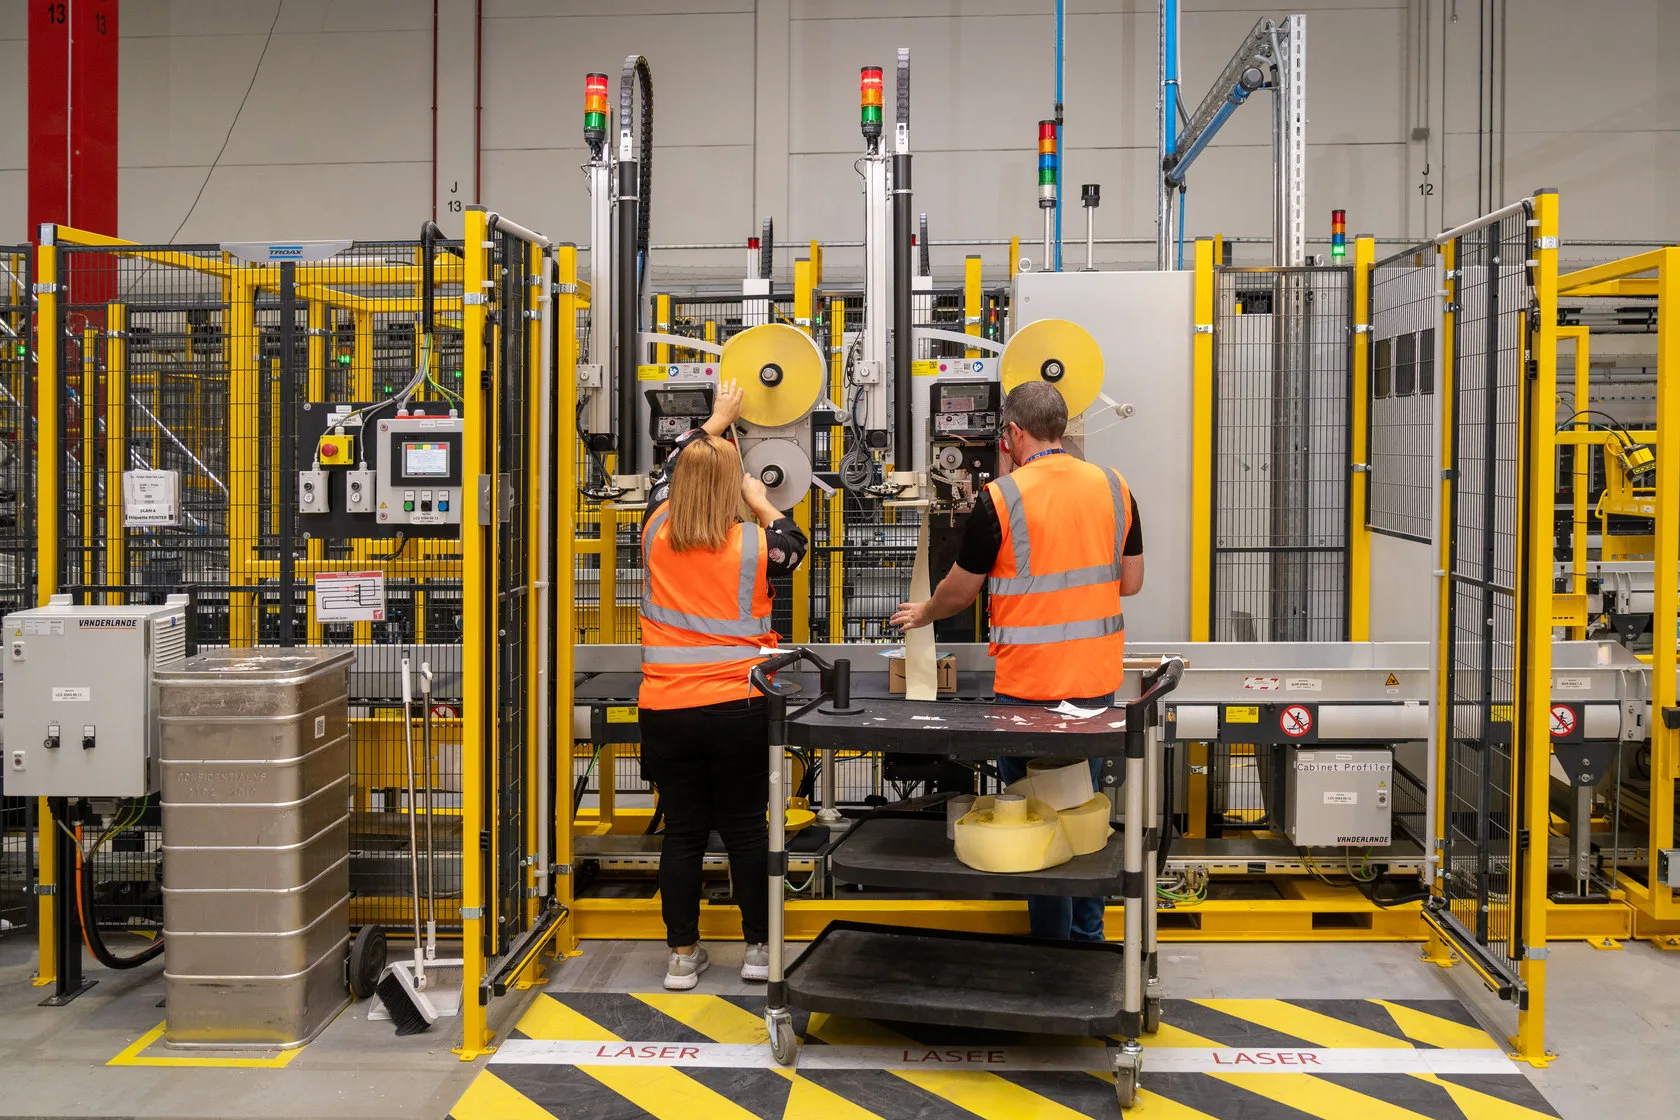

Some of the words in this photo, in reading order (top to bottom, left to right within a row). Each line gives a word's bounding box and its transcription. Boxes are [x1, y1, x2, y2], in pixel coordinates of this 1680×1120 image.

[48, 3, 66, 24] 13
[96, 13, 106, 35] 13
[1422, 163, 1430, 175] J
[450, 181, 458, 193] J
[1418, 183, 1434, 196] 12
[447, 200, 462, 212] 13
[79, 619, 137, 627] VANDERLANDE
[1297, 763, 1338, 771] Cabinet
[1344, 763, 1391, 772] Profiler
[596, 1045, 700, 1059] LASER
[902, 1050, 1006, 1063] LASEE
[1212, 1052, 1322, 1065] LASER
